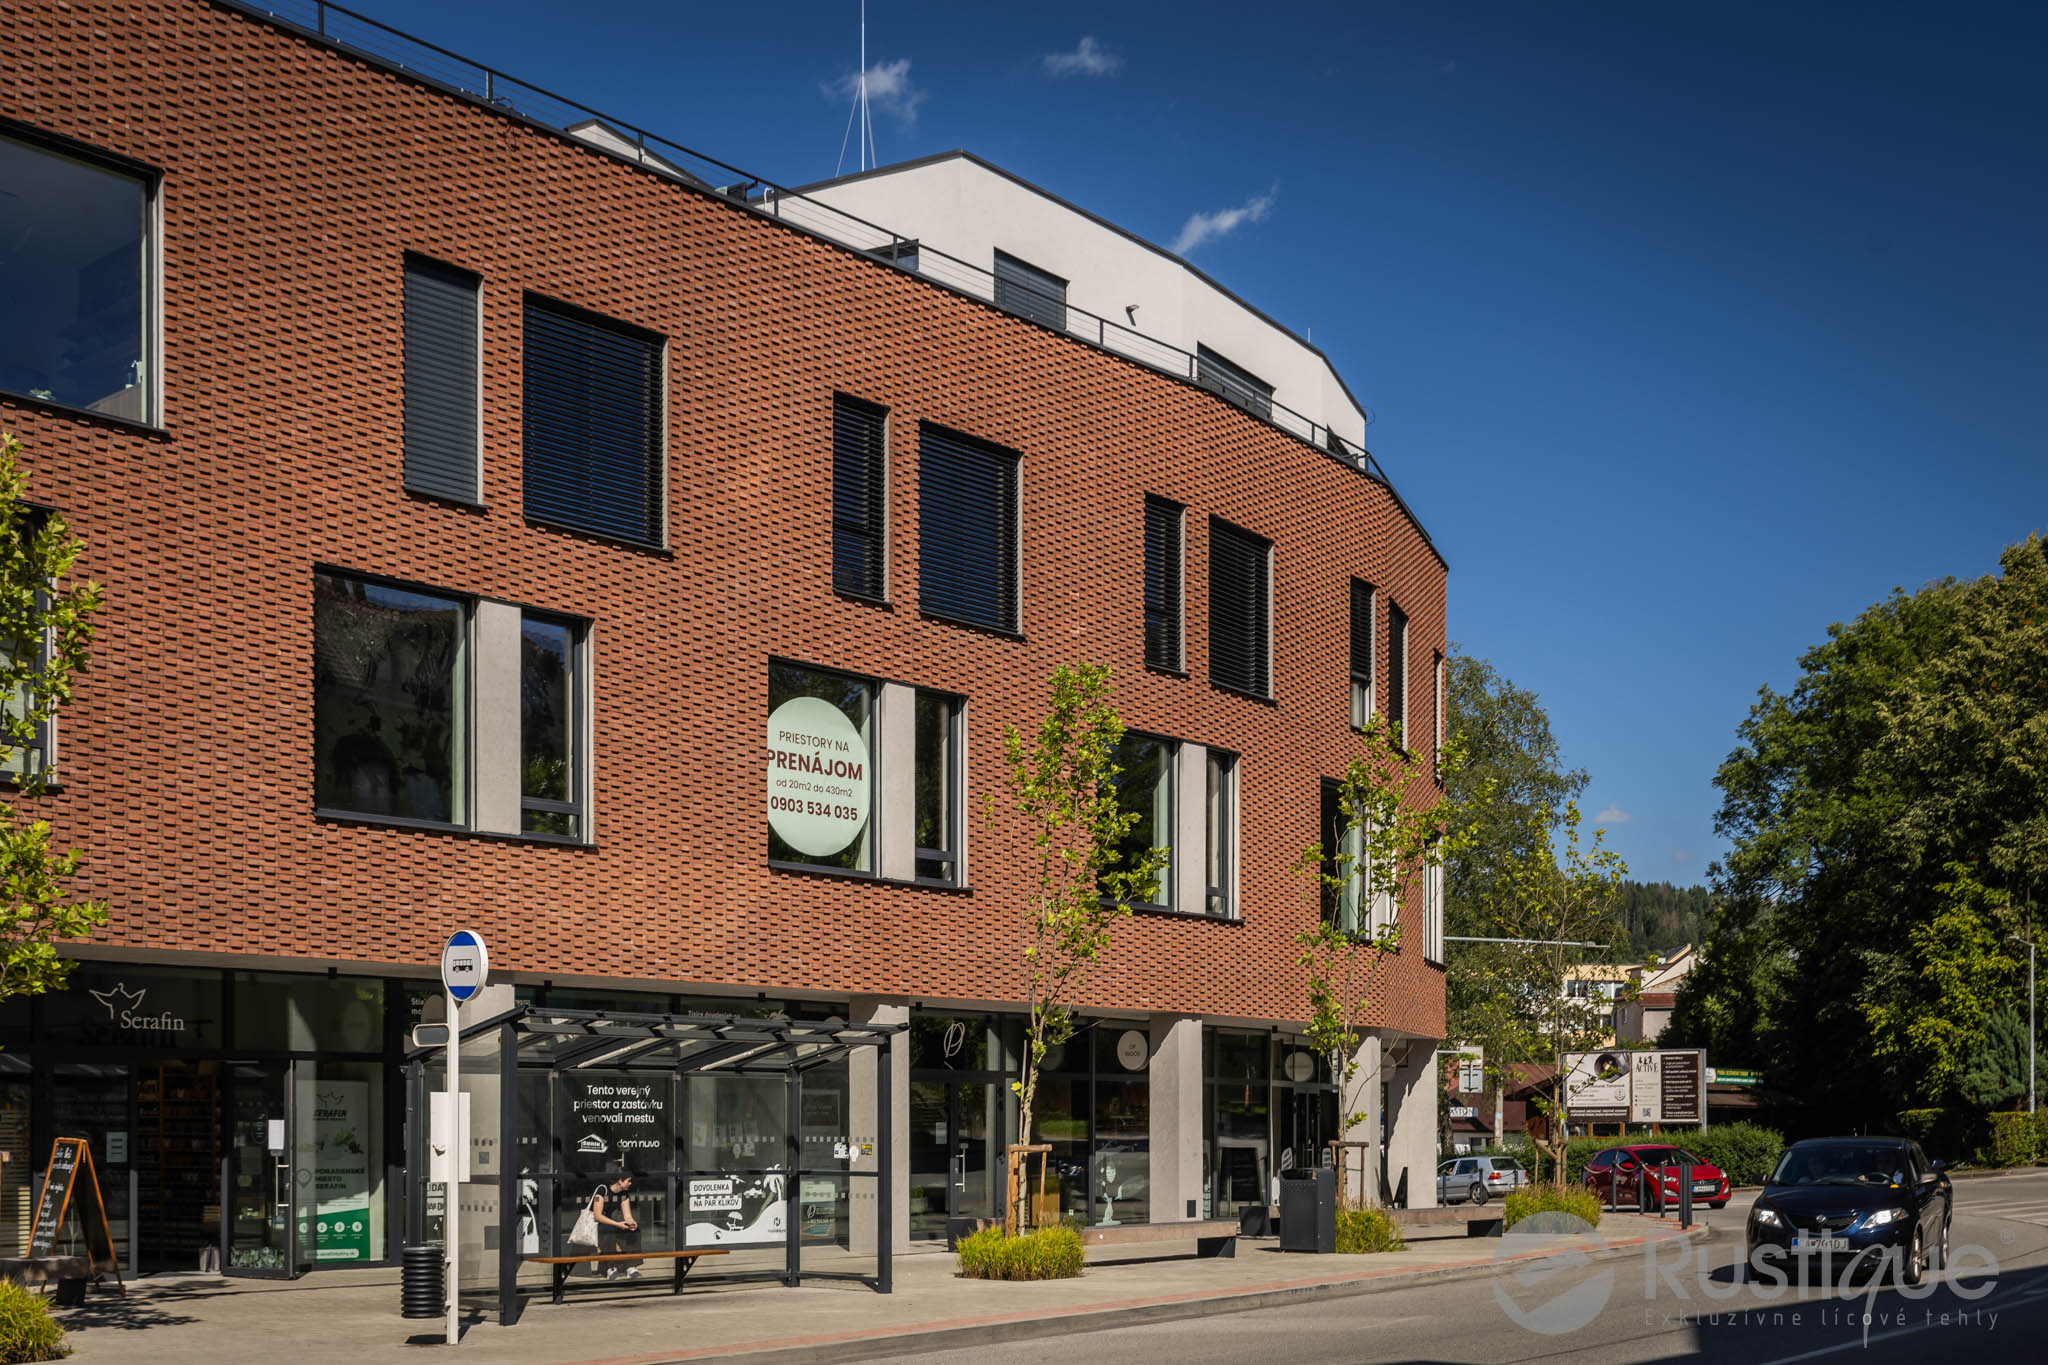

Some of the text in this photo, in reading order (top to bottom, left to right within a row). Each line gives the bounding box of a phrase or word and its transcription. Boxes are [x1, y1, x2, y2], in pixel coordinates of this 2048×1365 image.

[780, 731, 849, 752] PRIESTORY NA
[767, 749, 863, 781] PRENÁJOM
[776, 779, 853, 798] od 20m2 do 430m2
[770, 796, 858, 821] 0903 534 035
[120, 1010, 185, 1031] Serafin
[586, 1085, 651, 1098] Tento verejný
[573, 1099, 663, 1112] priestor a zastávku
[582, 1112, 655, 1124] venovali mestu
[617, 1139, 660, 1149] dom nuvo
[693, 1183, 730, 1192] DOVOLENKA
[693, 1200, 703, 1208] NA
[718, 1198, 739, 1207] KLIKOV
